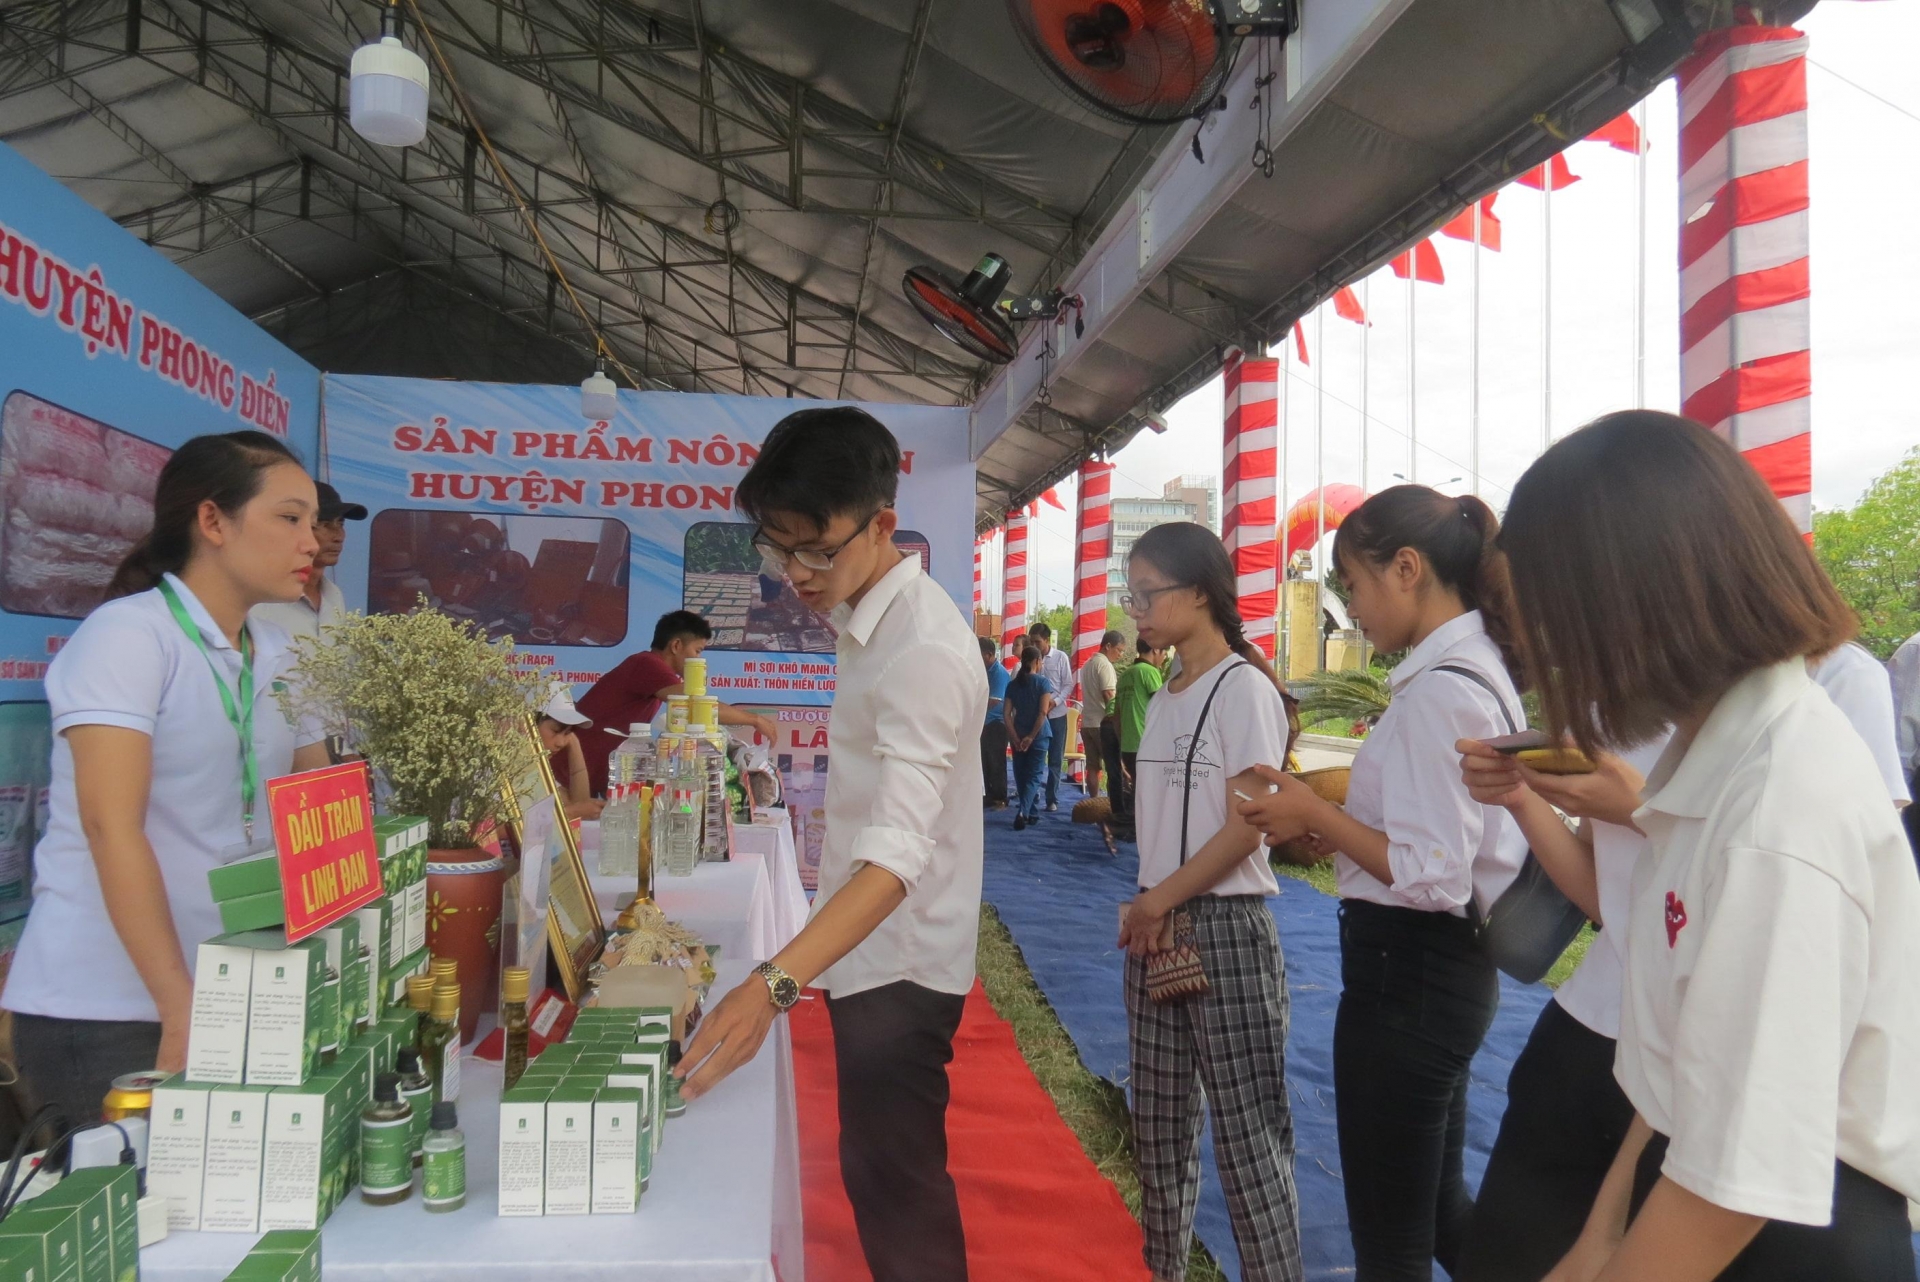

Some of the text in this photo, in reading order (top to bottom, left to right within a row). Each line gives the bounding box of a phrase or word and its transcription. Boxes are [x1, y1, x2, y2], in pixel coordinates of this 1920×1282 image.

[0, 227, 291, 438] HUYỆN PHONG ĐIỀN
[394, 417, 764, 468] SẢN PHẨM NÔN
[410, 470, 742, 511] HUYỆN PHON
[566, 671, 601, 683] PHONG
[711, 673, 731, 687] SẢN
[734, 674, 761, 689] XUẤT:
[764, 676, 789, 689] THÔN
[817, 679, 836, 691] LƯƠ
[744, 660, 756, 673] MÌ
[760, 662, 775, 676] SỢI
[778, 662, 798, 674] KHÔ
[801, 664, 830, 677] MẠNH
[778, 709, 830, 725] RƯỢU
[791, 725, 829, 749] LÂ
[287, 789, 364, 856] DẦU TRÀM
[301, 850, 369, 915] LINH ĐAN
